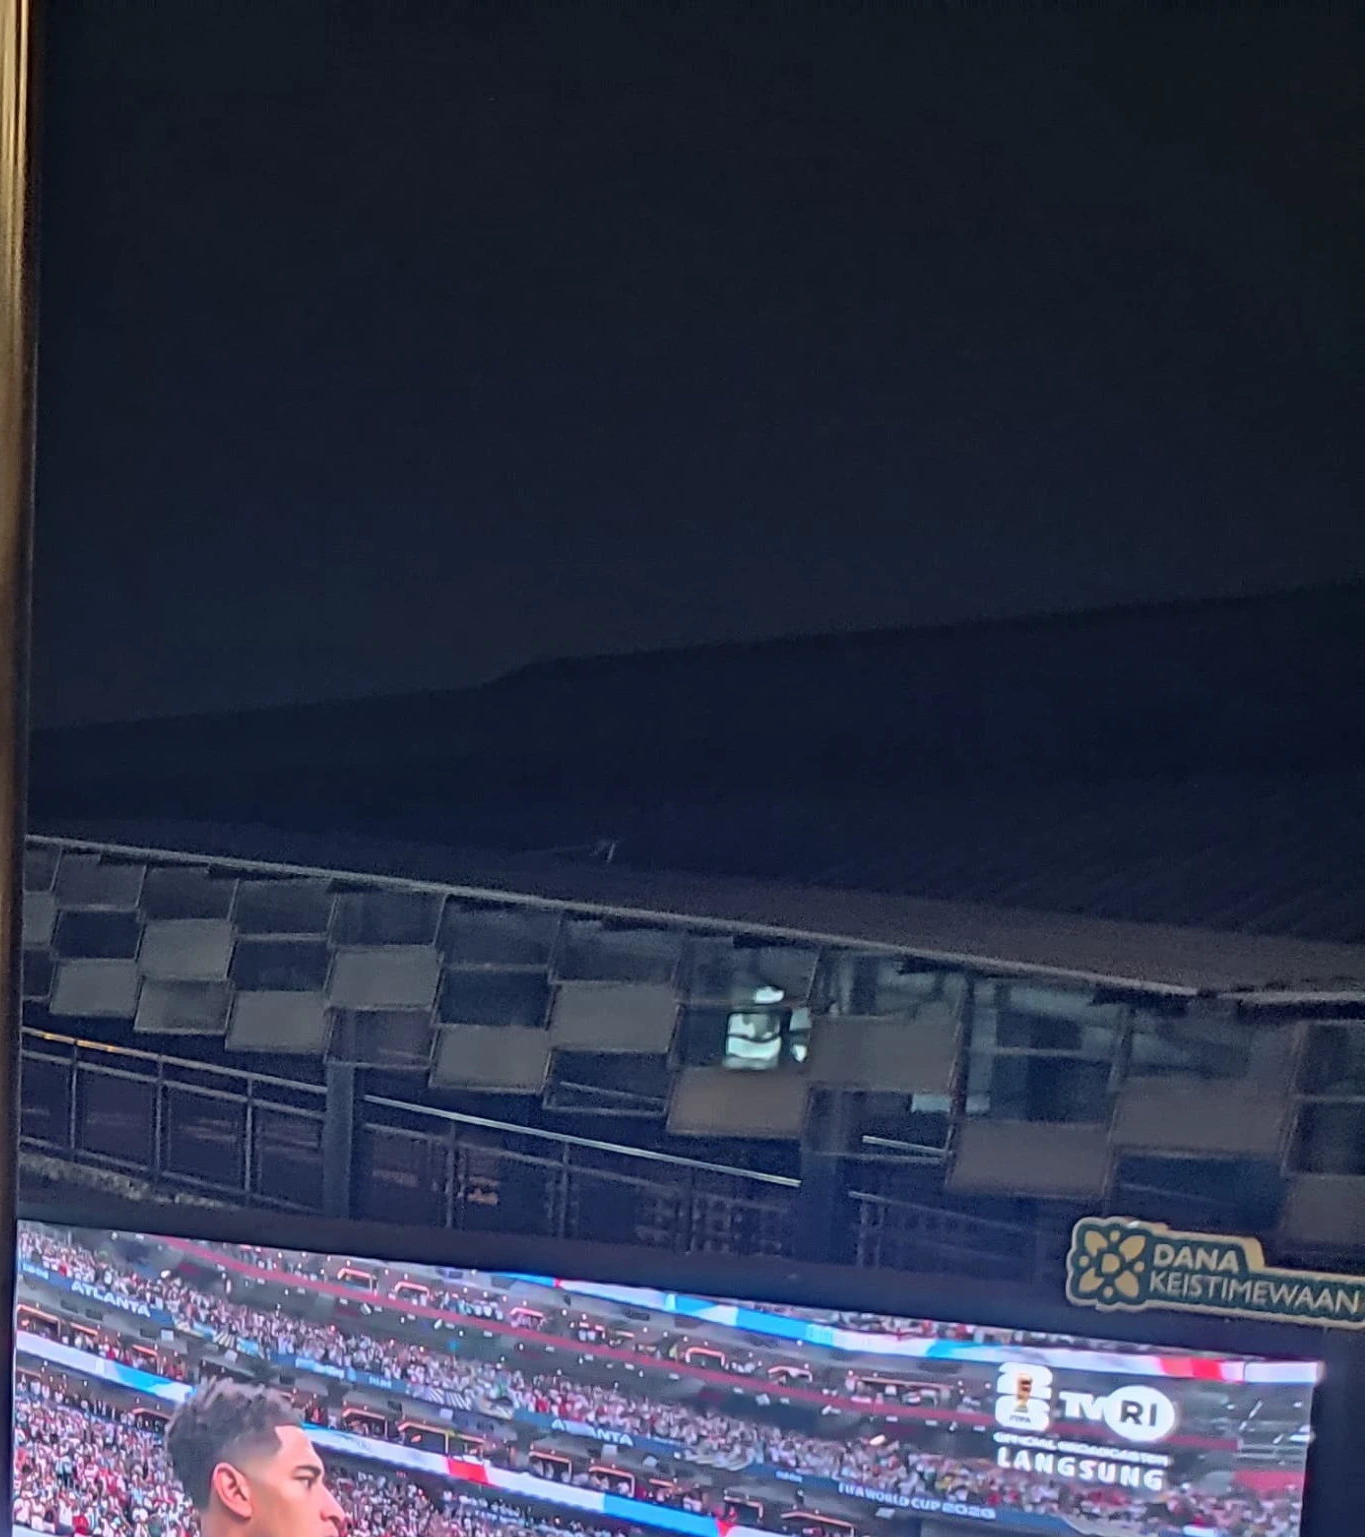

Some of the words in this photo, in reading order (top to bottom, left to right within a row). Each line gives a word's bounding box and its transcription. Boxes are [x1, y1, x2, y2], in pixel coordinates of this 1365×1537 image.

[1153, 1243, 1240, 1275] DANA
[71, 1280, 151, 1318] ATLANTA
[1149, 1270, 1361, 1315] KEISTIMEWAAN
[996, 1446, 1164, 1492] LANGSUNG
[838, 1482, 865, 1499] FIFA
[866, 1490, 910, 1508] WORLD
[911, 1496, 940, 1512] CUP
